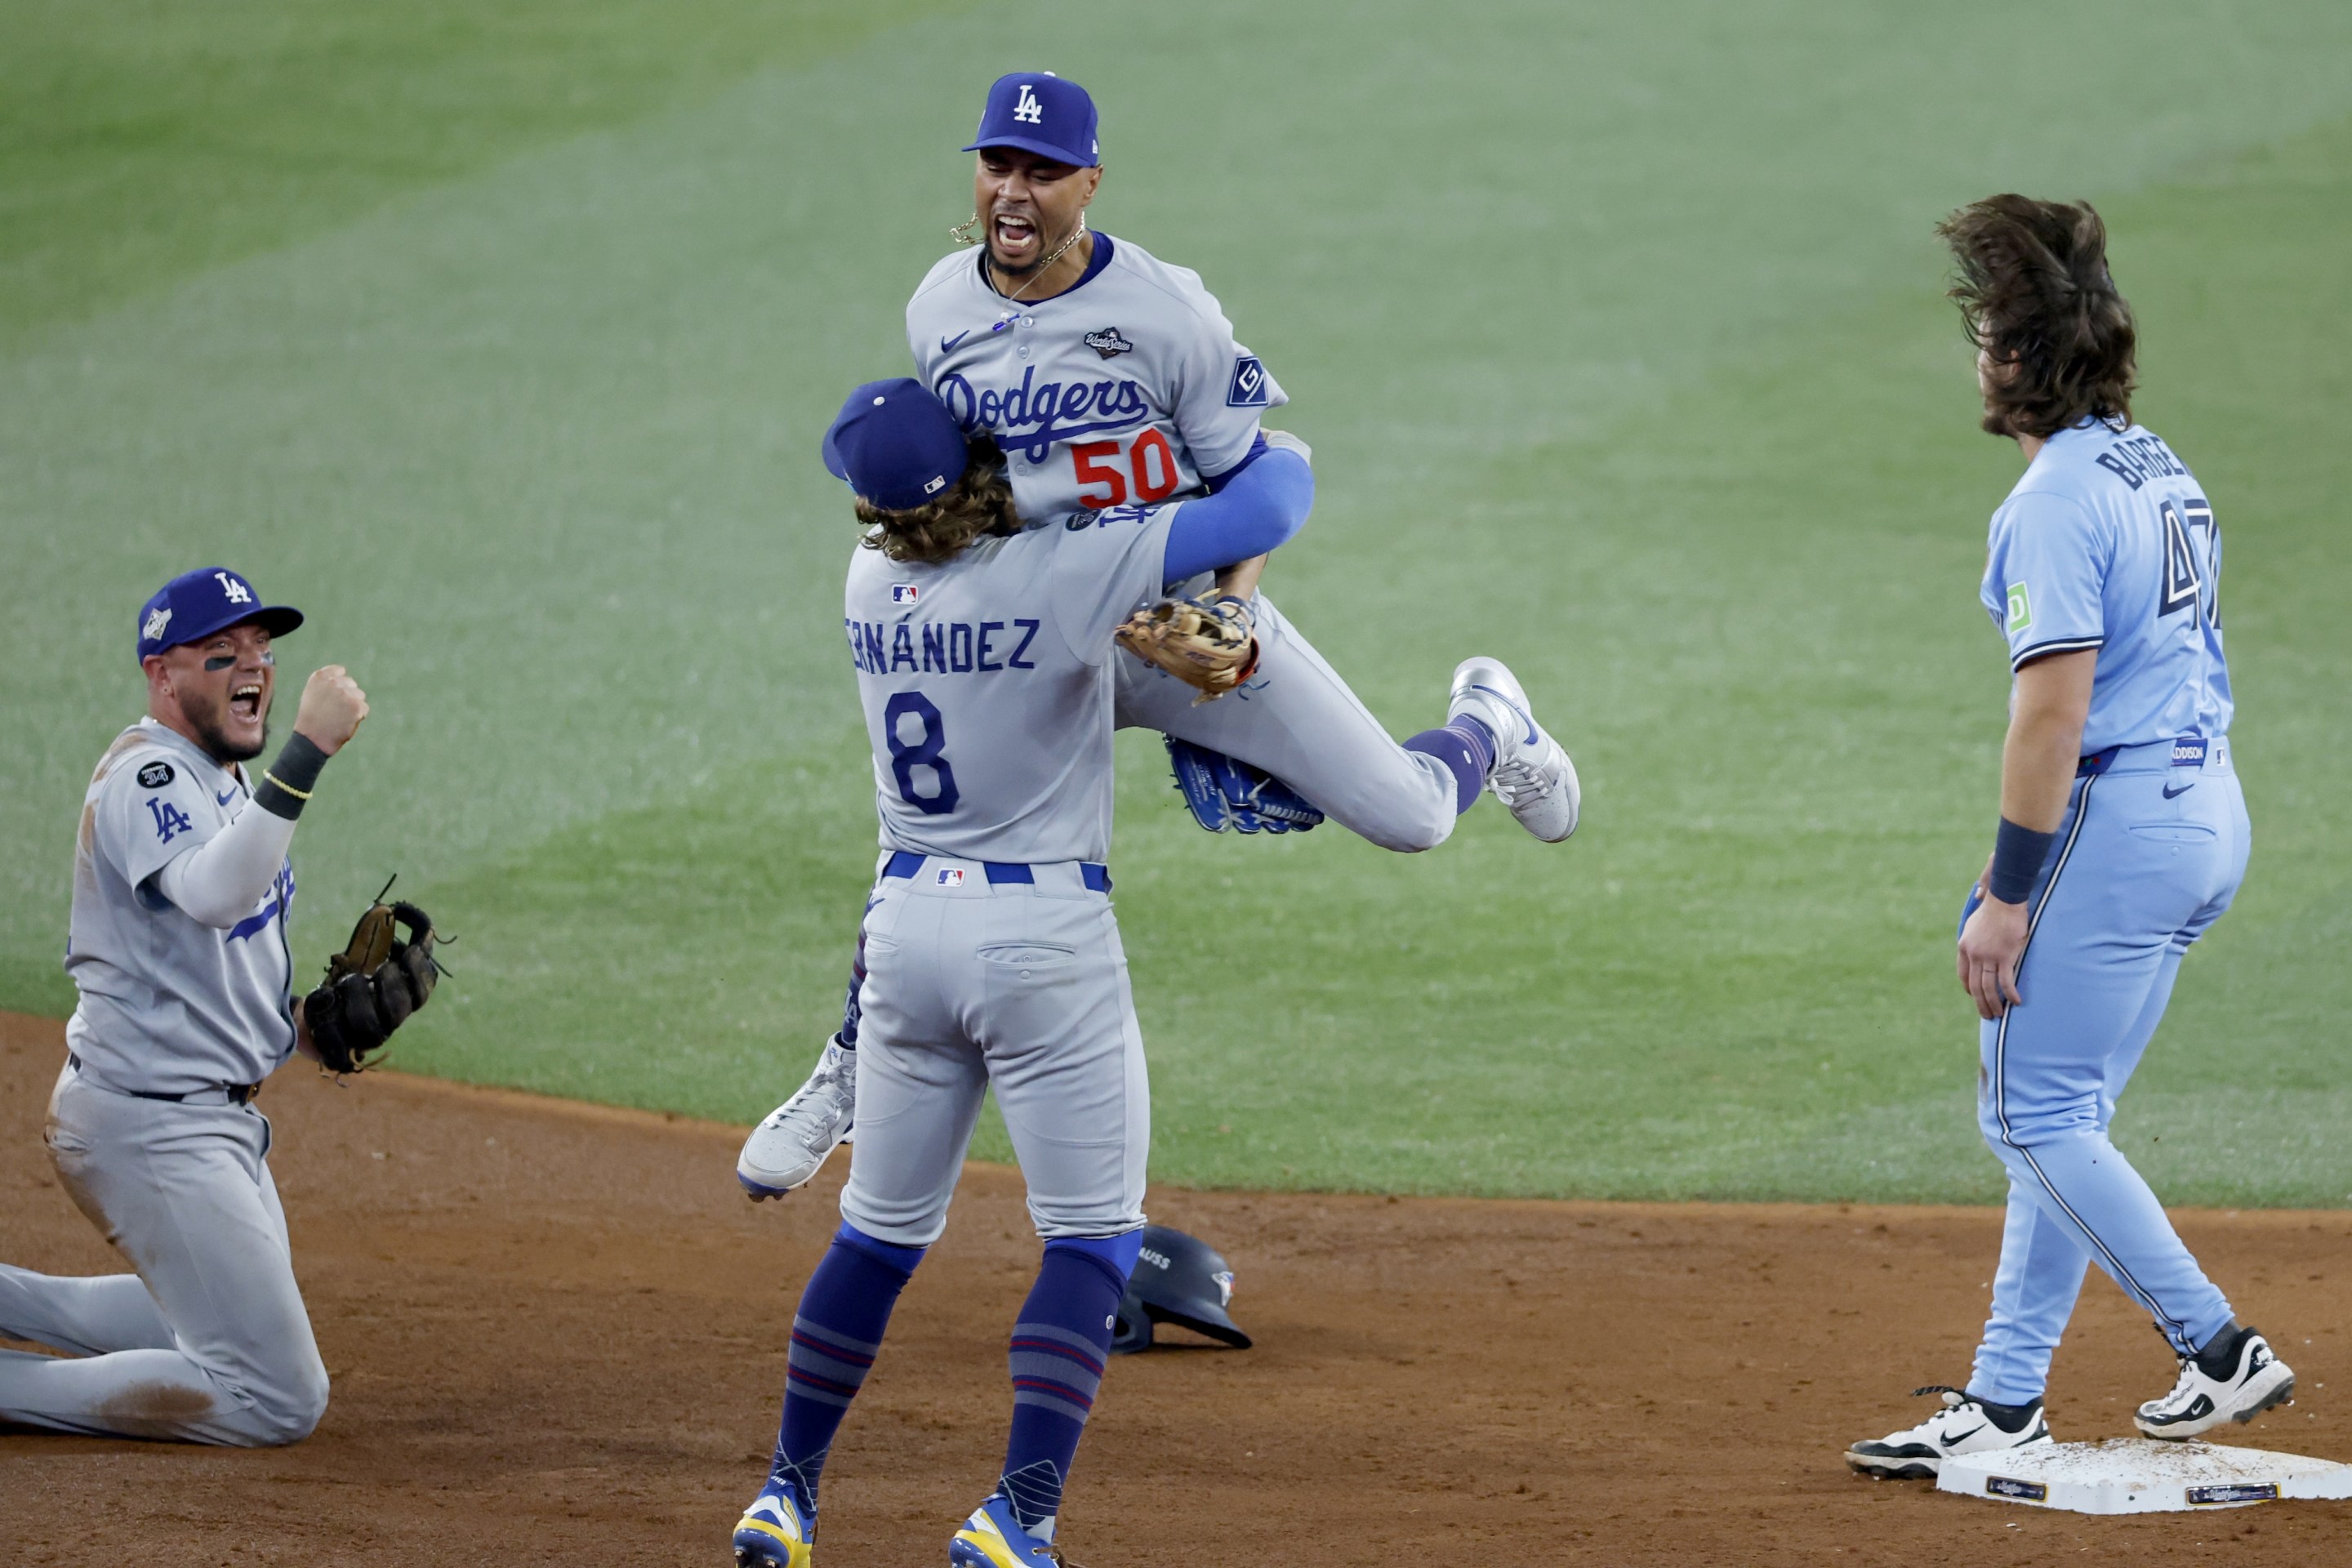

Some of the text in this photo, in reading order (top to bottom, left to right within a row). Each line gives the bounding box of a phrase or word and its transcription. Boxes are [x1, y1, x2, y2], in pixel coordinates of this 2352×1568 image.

[1013, 85, 1042, 124] LA
[939, 365, 1146, 464] Dodgers
[1071, 427, 1178, 509] 50
[2095, 436, 2196, 491] BARGE
[214, 572, 252, 604] LA
[2158, 499, 2221, 631] 47
[145, 768, 169, 785] 34
[884, 691, 960, 814] 8
[146, 796, 193, 844] LA
